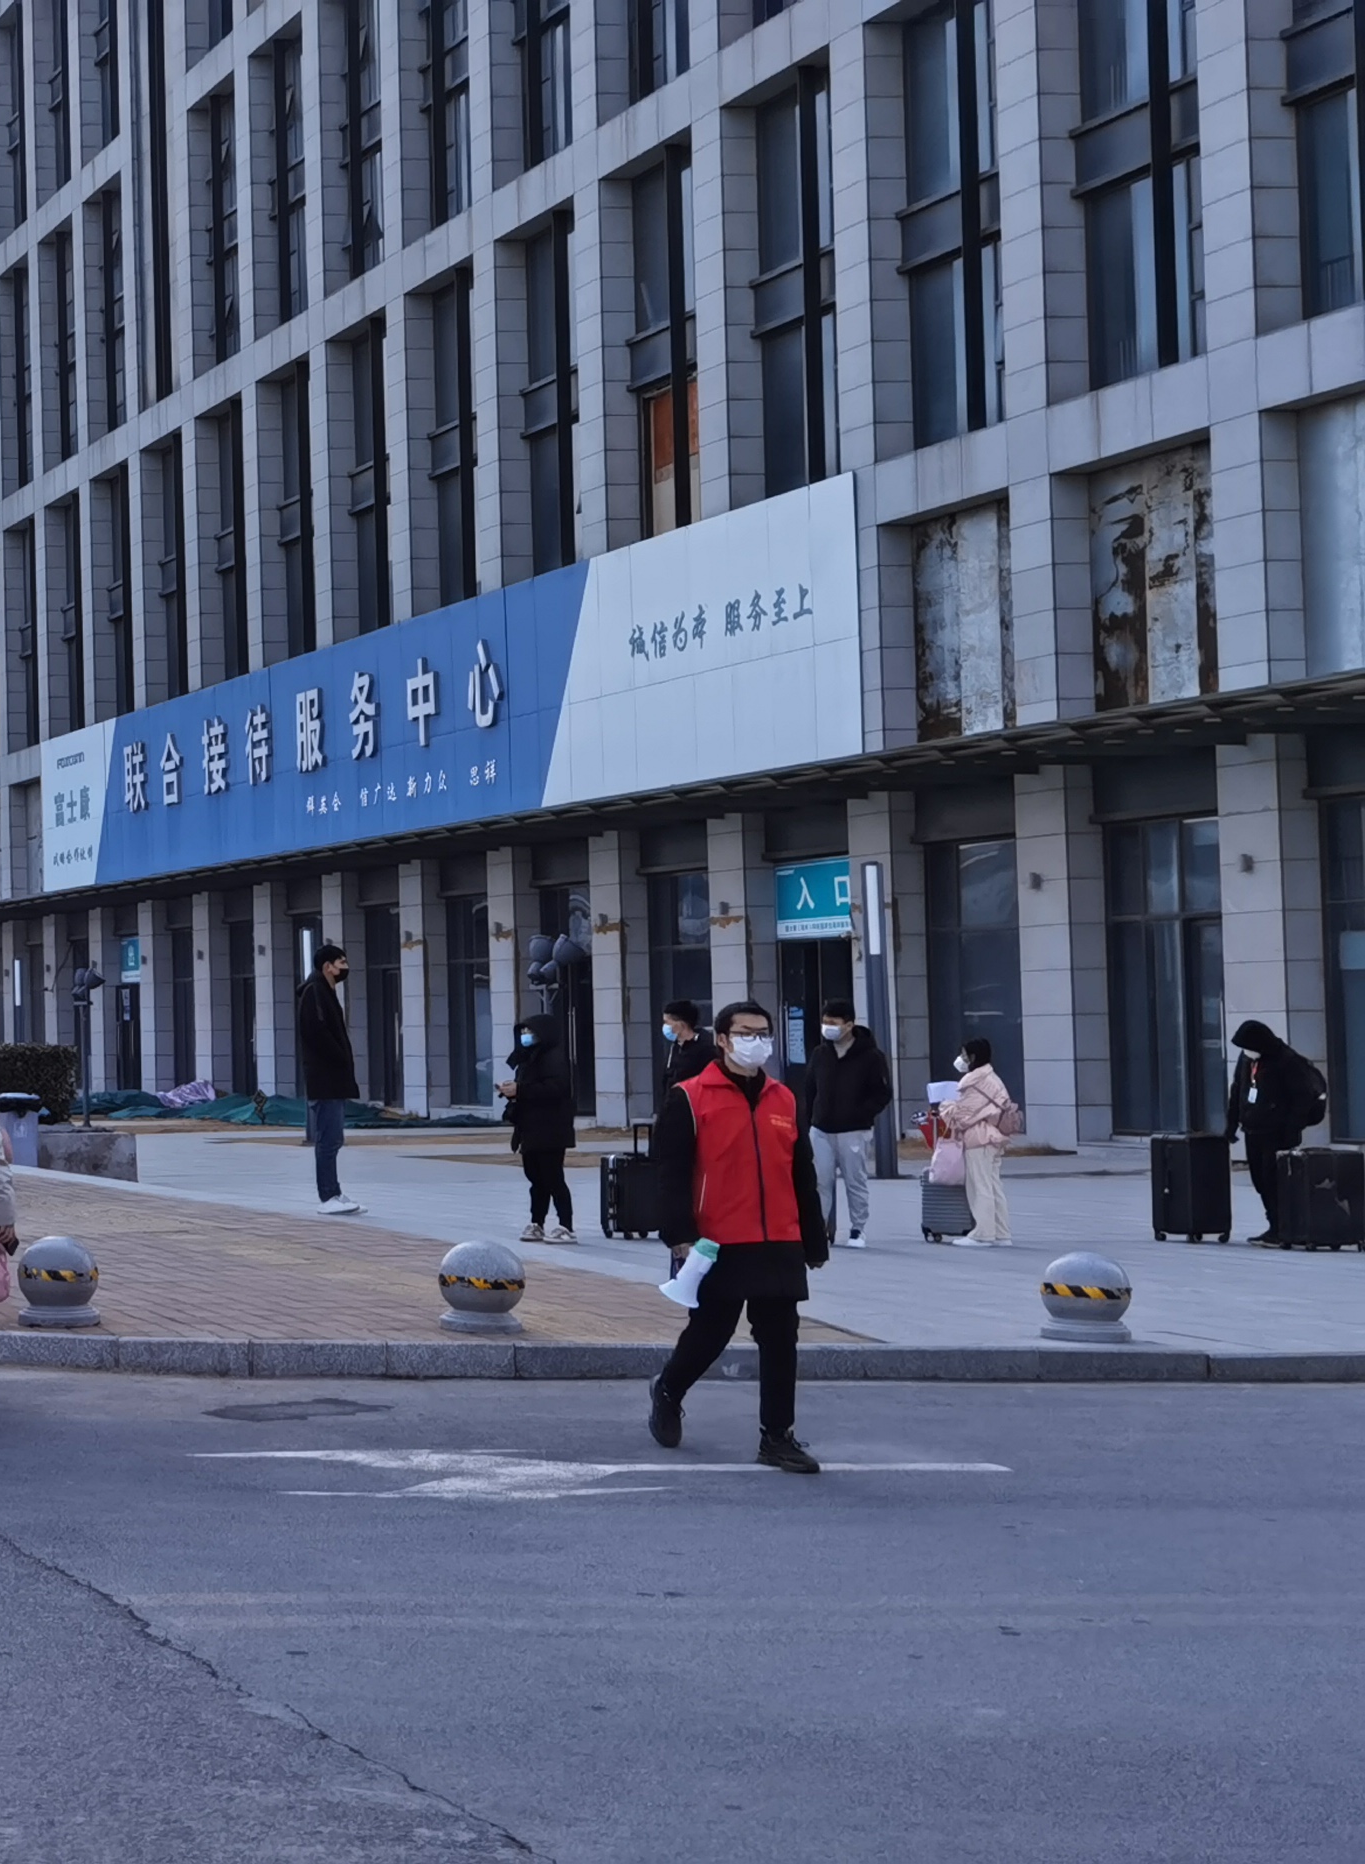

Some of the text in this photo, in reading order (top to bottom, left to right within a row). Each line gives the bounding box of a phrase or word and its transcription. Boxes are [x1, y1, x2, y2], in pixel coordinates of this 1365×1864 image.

[629, 583, 813, 662] 诚信为本 服务至上
[123, 639, 502, 812] 联合接待服务中心
[54, 785, 90, 827] 富士康
[796, 874, 851, 910] 入口
